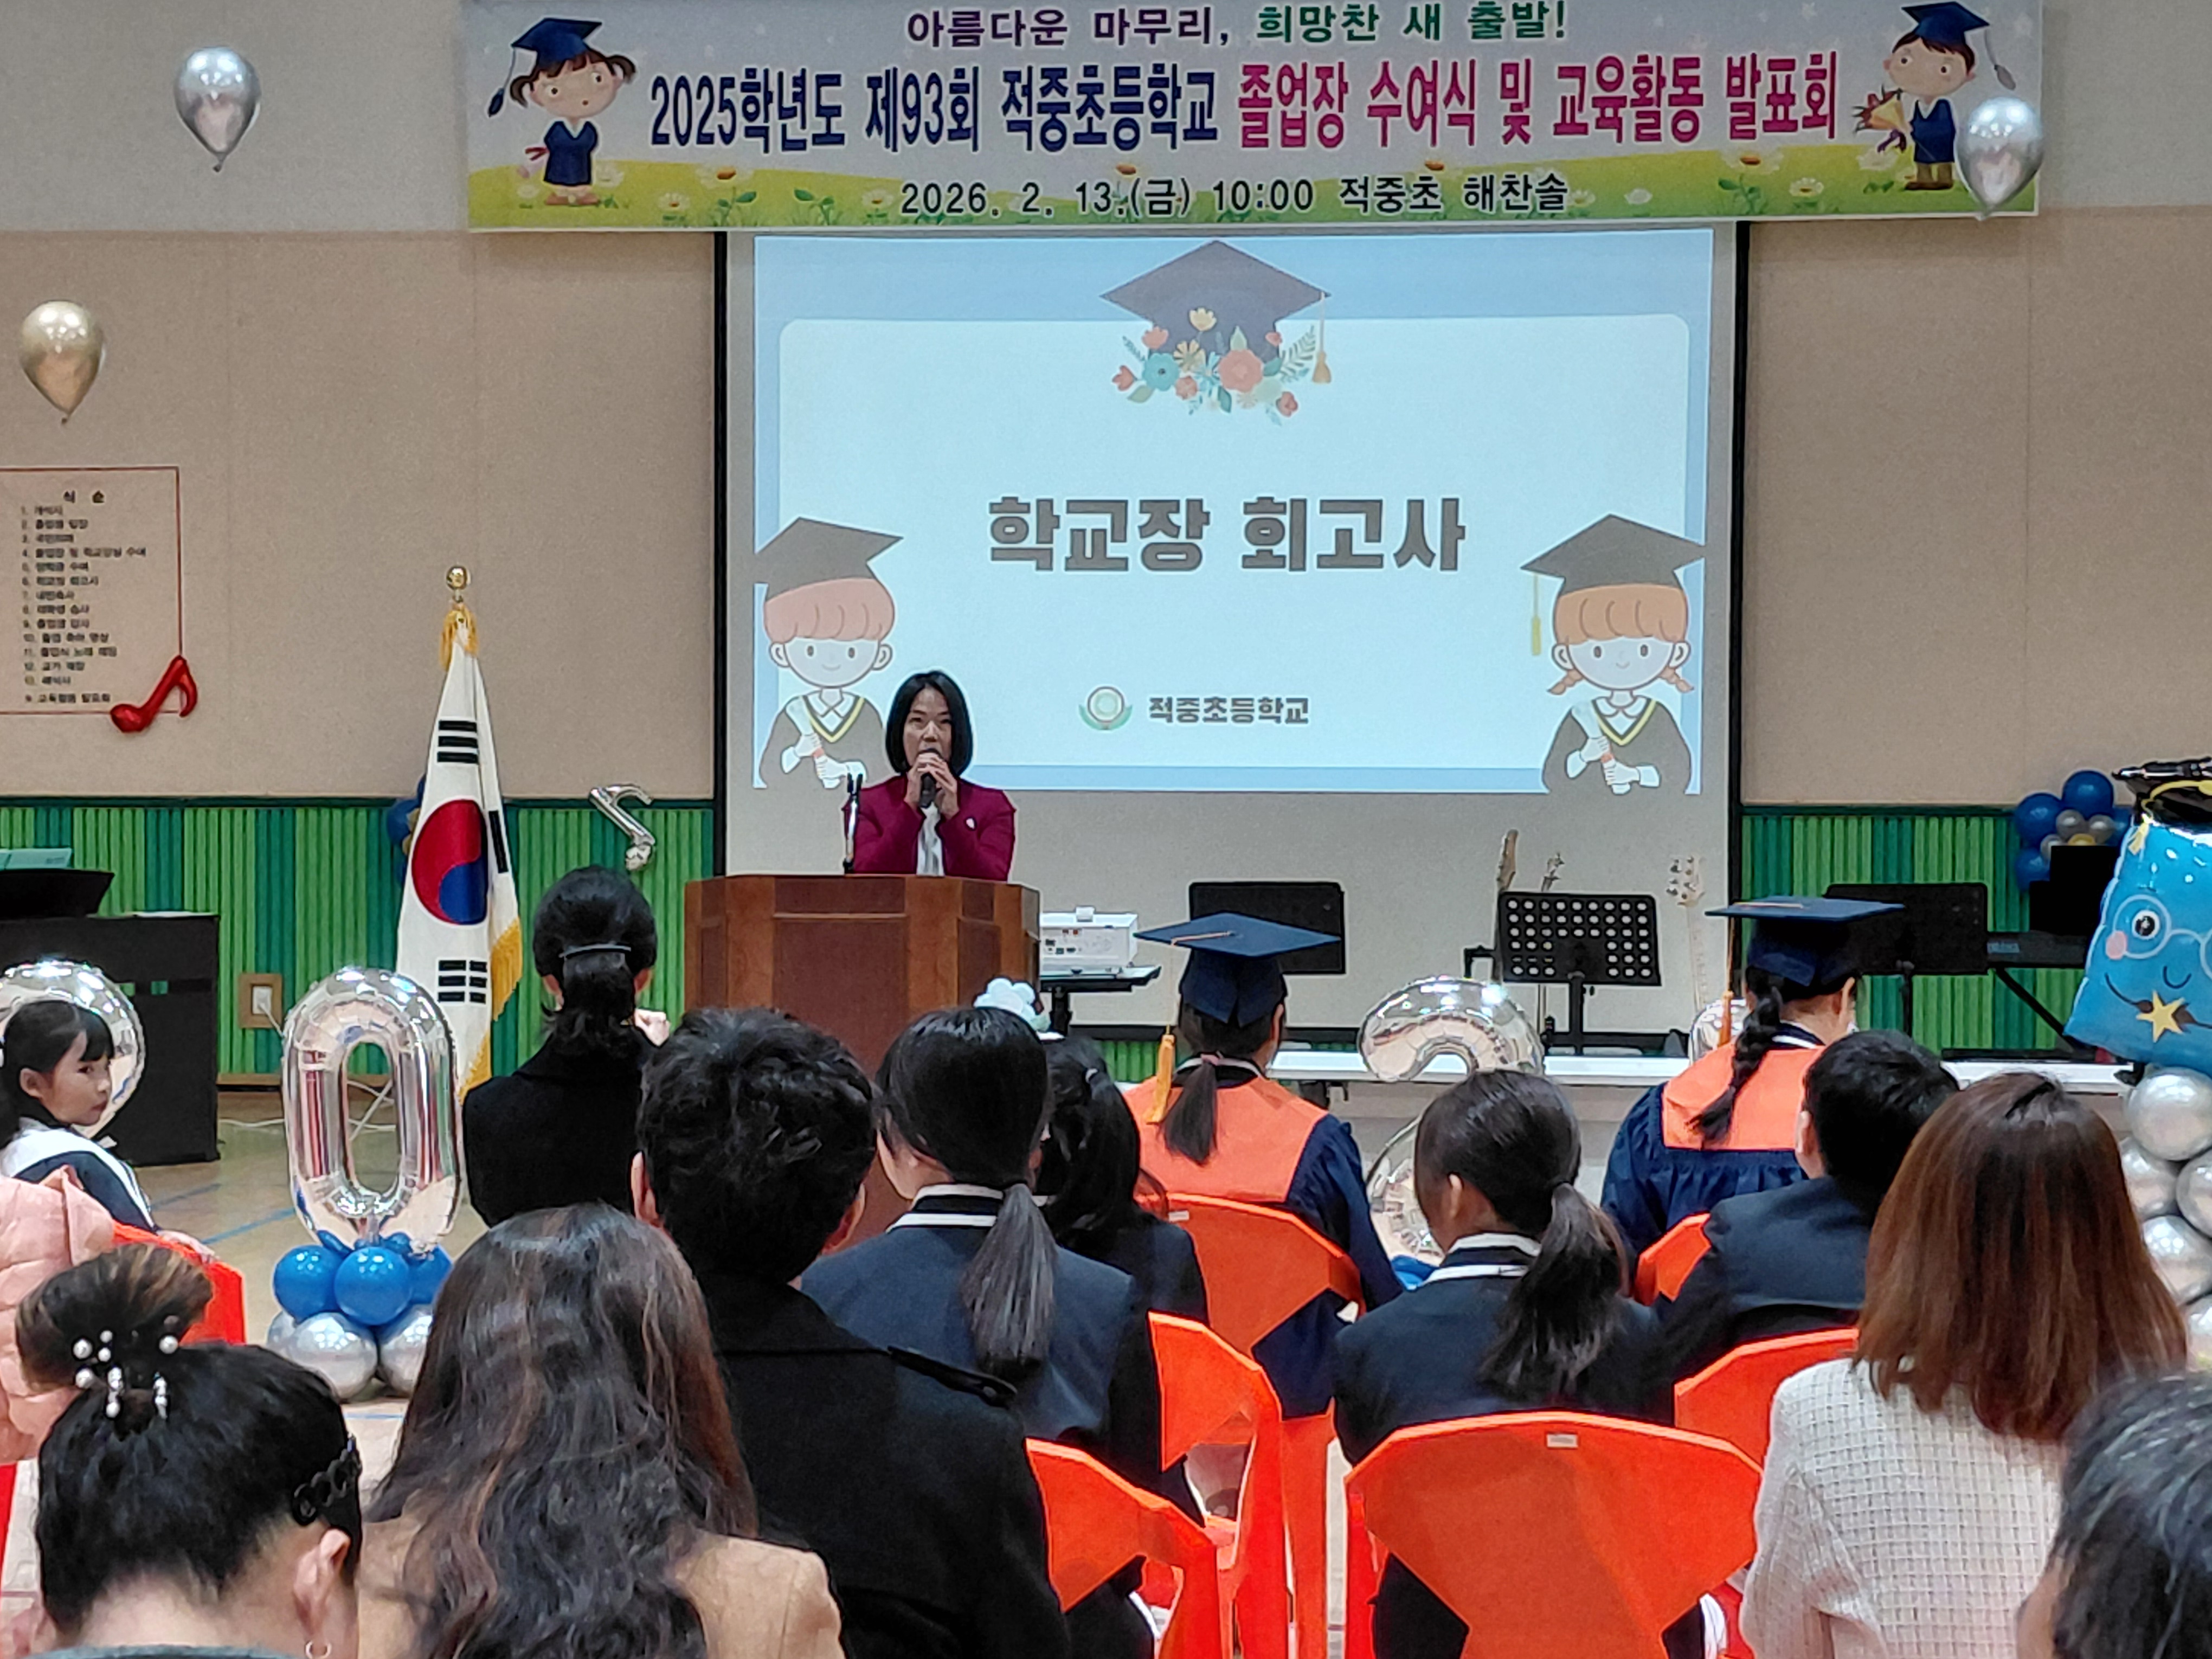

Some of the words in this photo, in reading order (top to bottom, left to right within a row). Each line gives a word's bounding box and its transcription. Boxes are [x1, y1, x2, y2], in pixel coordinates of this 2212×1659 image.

[907, 9, 1068, 48] 아름다운
[1094, 6, 1229, 47] 마무리,
[1256, 3, 1380, 43] 희망찬
[1403, 3, 1441, 41] 새
[1467, 0, 1565, 40] 출발!
[651, 67, 846, 155] 2025학년도
[864, 65, 980, 153] 제93회
[1000, 62, 1218, 153] 적중초등학교
[1238, 61, 1349, 149] 졸업장
[1366, 58, 1476, 148] 수여식
[1499, 57, 1532, 145] 및
[1552, 53, 1705, 144] 교육활동
[1725, 50, 1837, 141] 발표회
[901, 182, 999, 216] 2026.
[1020, 182, 1053, 216] 2.
[1076, 178, 1192, 216] 13.(금)
[1212, 179, 1314, 211] 10:00
[1339, 175, 1443, 212] 적중초
[1463, 172, 1569, 211] 해찬솔
[989, 496, 1211, 572] 학교장
[1241, 496, 1466, 572] 회고사
[1149, 696, 1309, 724] 적중초등학교
